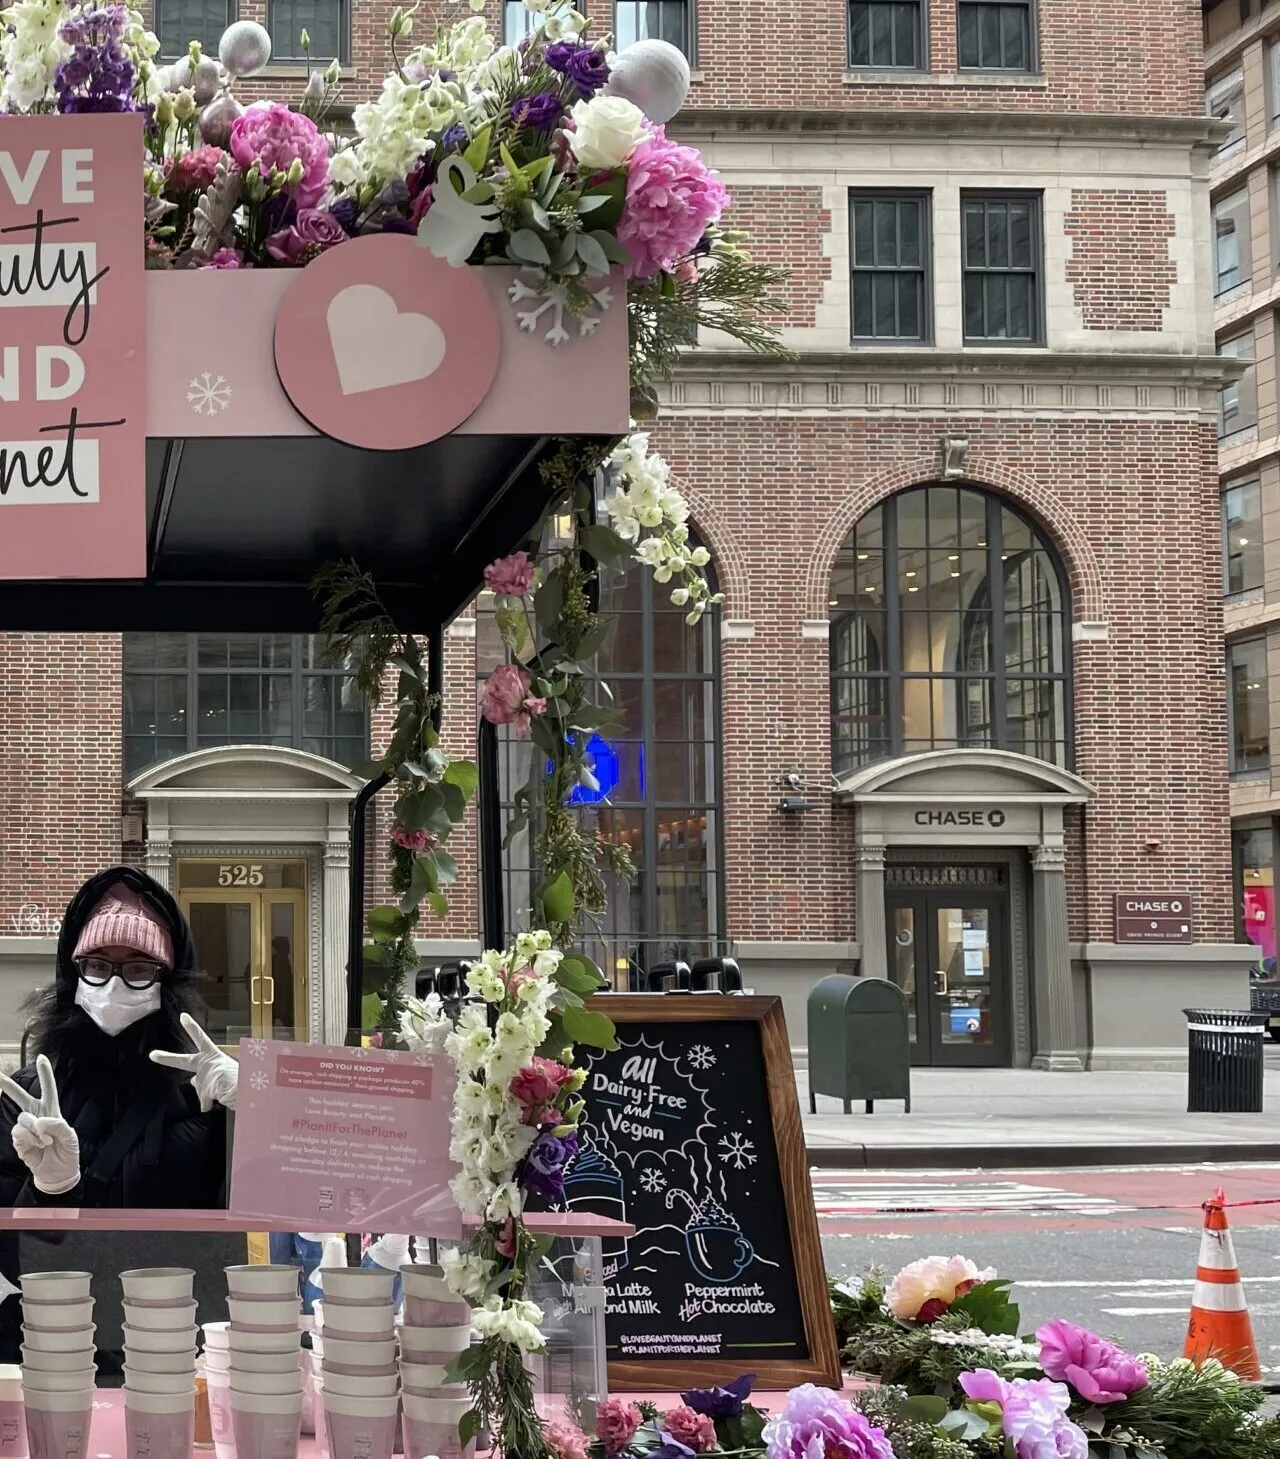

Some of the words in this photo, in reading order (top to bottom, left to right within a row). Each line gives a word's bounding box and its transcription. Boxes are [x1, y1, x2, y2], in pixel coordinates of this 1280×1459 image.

[915, 810, 984, 826] CHASE
[218, 865, 263, 886] 525
[1126, 901, 1169, 911] CHASE
[335, 1063, 352, 1071] YOU
[353, 1064, 384, 1073] KNOW?
[622, 1055, 657, 1084] all
[623, 1104, 652, 1119] and
[607, 1108, 664, 1141] Vegan
[617, 1283, 652, 1296] Latte
[685, 1283, 764, 1299] Peppermint
[575, 1300, 626, 1314] Alond
[629, 1300, 661, 1314] Milk
[678, 1299, 702, 1321] Hot
[702, 1300, 776, 1314] Chocolate
